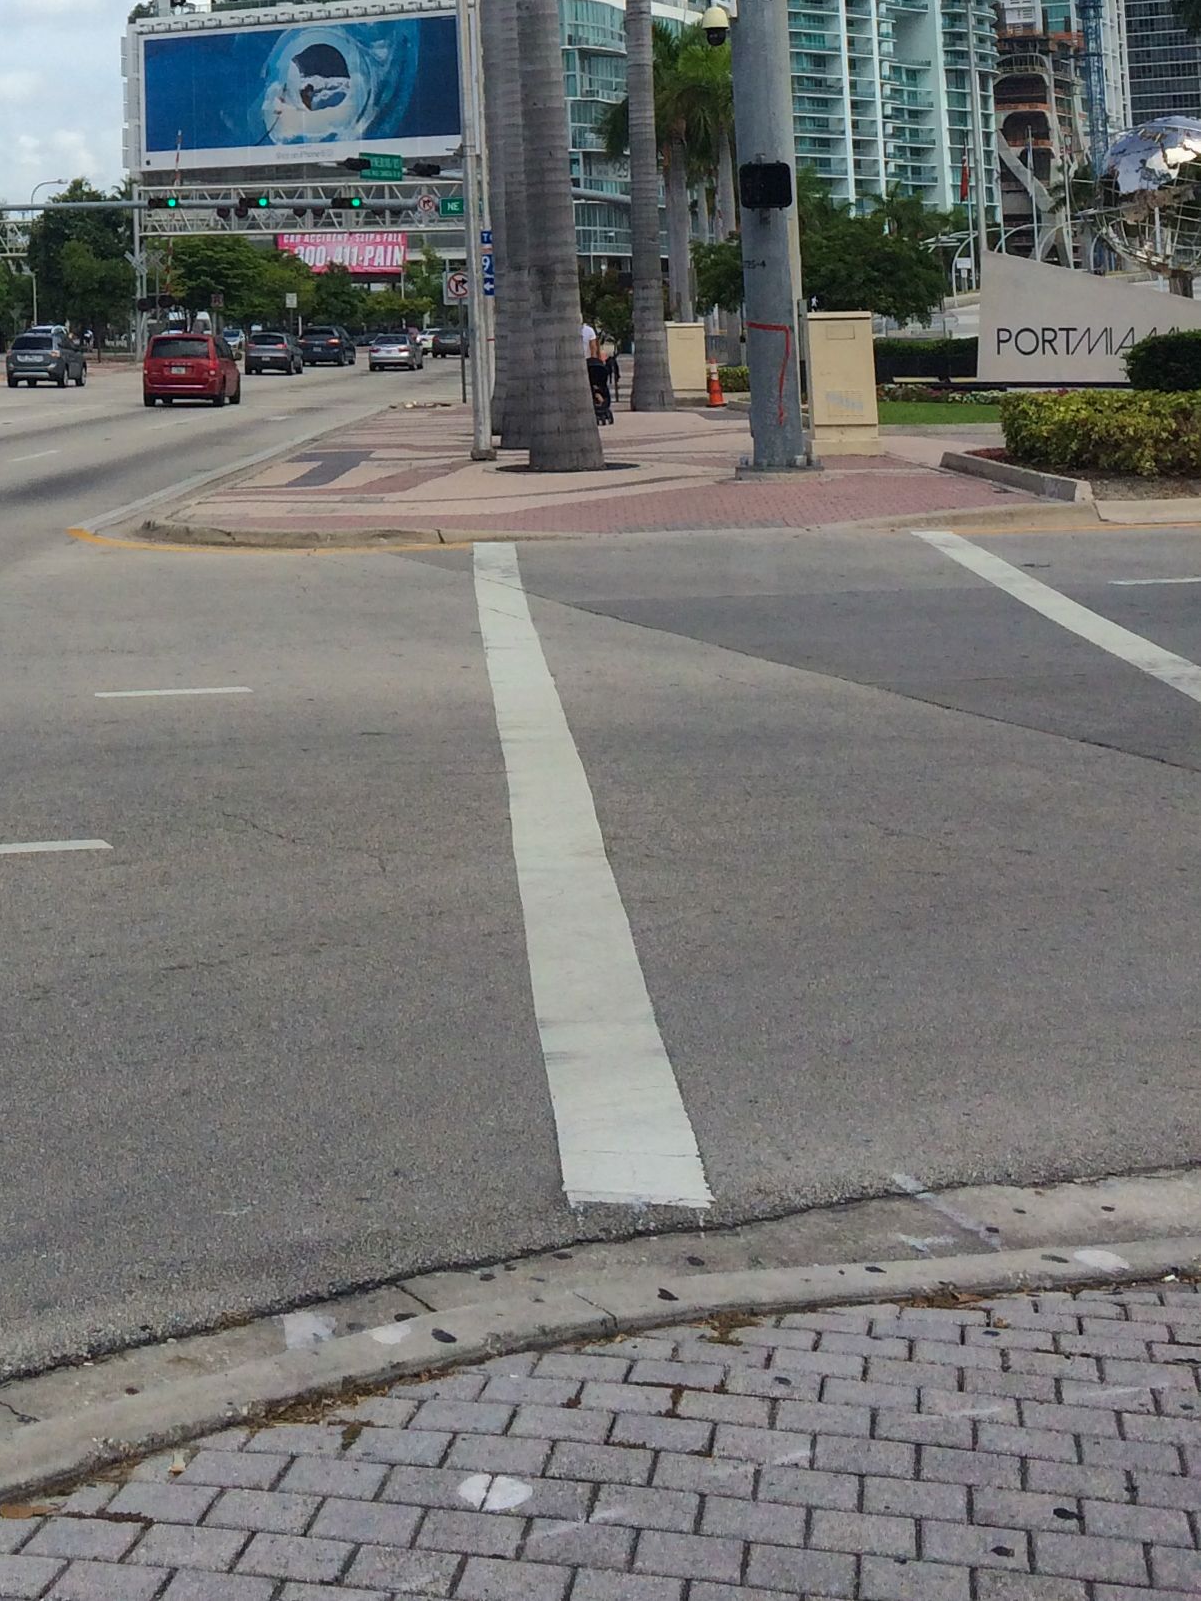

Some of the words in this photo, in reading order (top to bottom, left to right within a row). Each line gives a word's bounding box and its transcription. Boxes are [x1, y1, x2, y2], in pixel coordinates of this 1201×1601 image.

[447, 202, 460, 211] NE
[283, 234, 301, 243] CAR
[303, 234, 349, 243] ACCIDENT
[355, 233, 375, 243] SLIP
[383, 233, 402, 242] FALL
[997, 327, 1180, 355] PORTMIA
